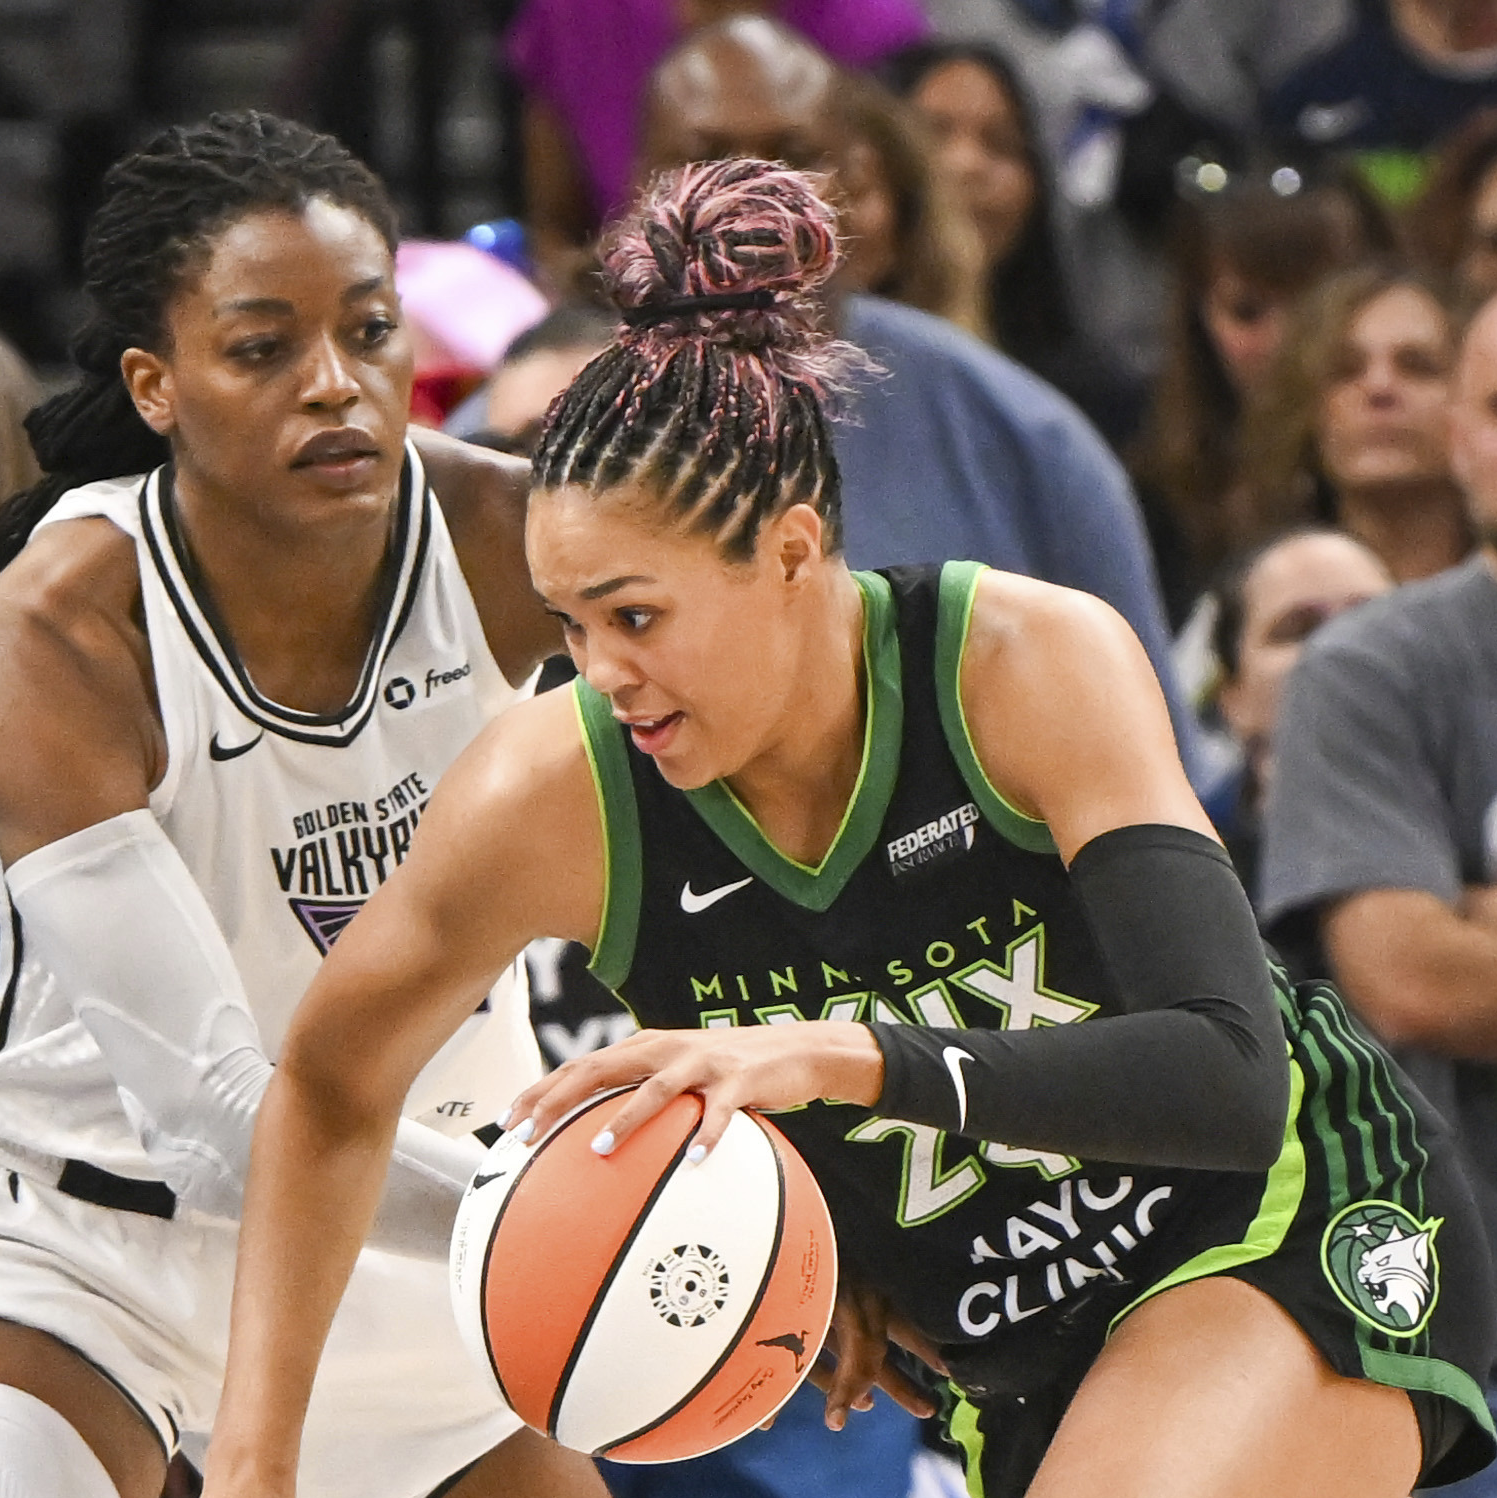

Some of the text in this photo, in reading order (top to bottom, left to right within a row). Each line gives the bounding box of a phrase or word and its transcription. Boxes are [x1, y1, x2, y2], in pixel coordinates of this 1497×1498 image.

[293, 771, 428, 840] GOLDEN STATE
[887, 802, 980, 863] FEDERATED
[690, 898, 1037, 1003] MINNSOTA
